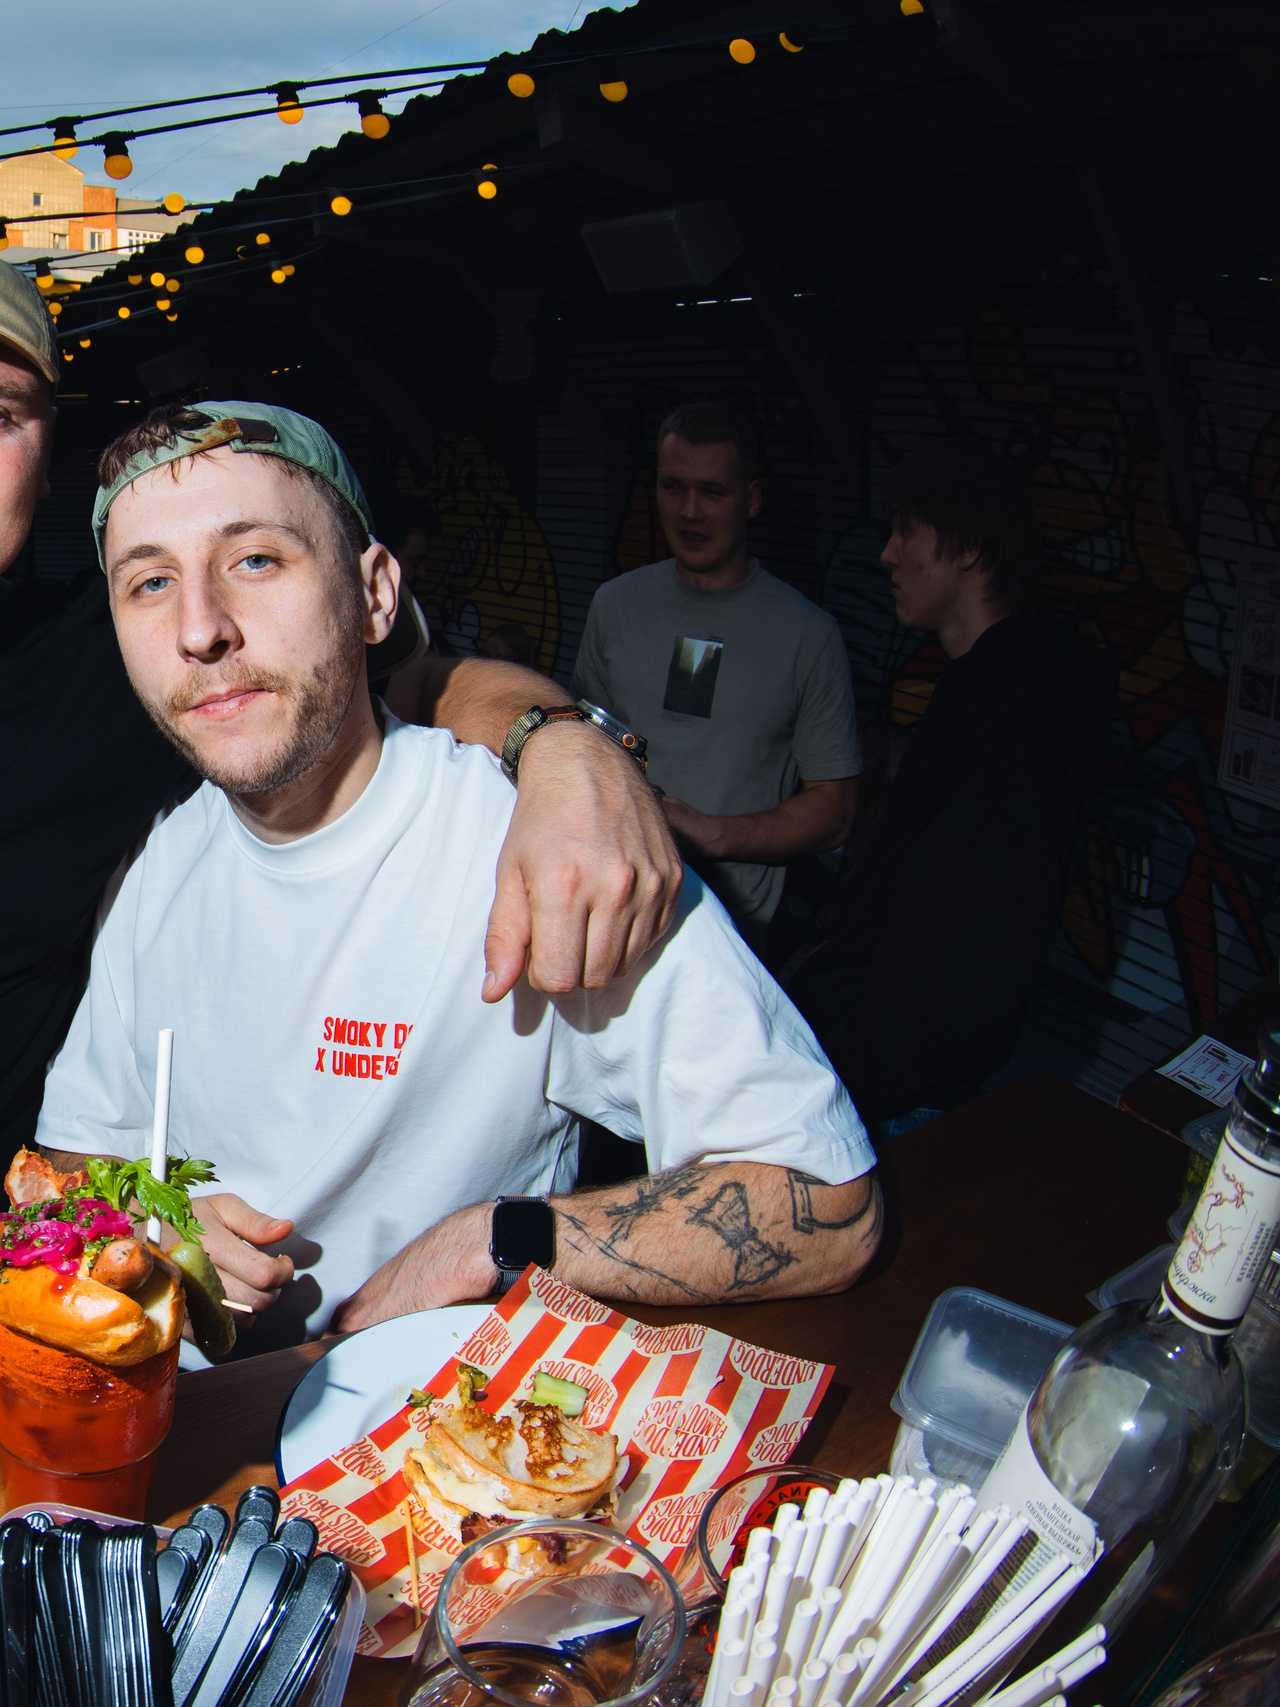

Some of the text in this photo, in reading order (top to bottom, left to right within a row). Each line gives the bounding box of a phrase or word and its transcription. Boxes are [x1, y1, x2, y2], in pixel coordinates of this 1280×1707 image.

[1247, 609, 1277, 625] Food
[323, 1016, 414, 1049] SMOKY D
[315, 1047, 326, 1072] X
[532, 1272, 607, 1322] UNDERDOG
[630, 1324, 707, 1355] UNDERDOG
[733, 1343, 817, 1386] UNDERDOG
[758, 1423, 794, 1444] DOGS
[651, 1494, 689, 1520] DOGS
[1052, 1501, 1073, 1524] ВОДКА
[293, 1491, 382, 1558] FAMOUS DOGS
